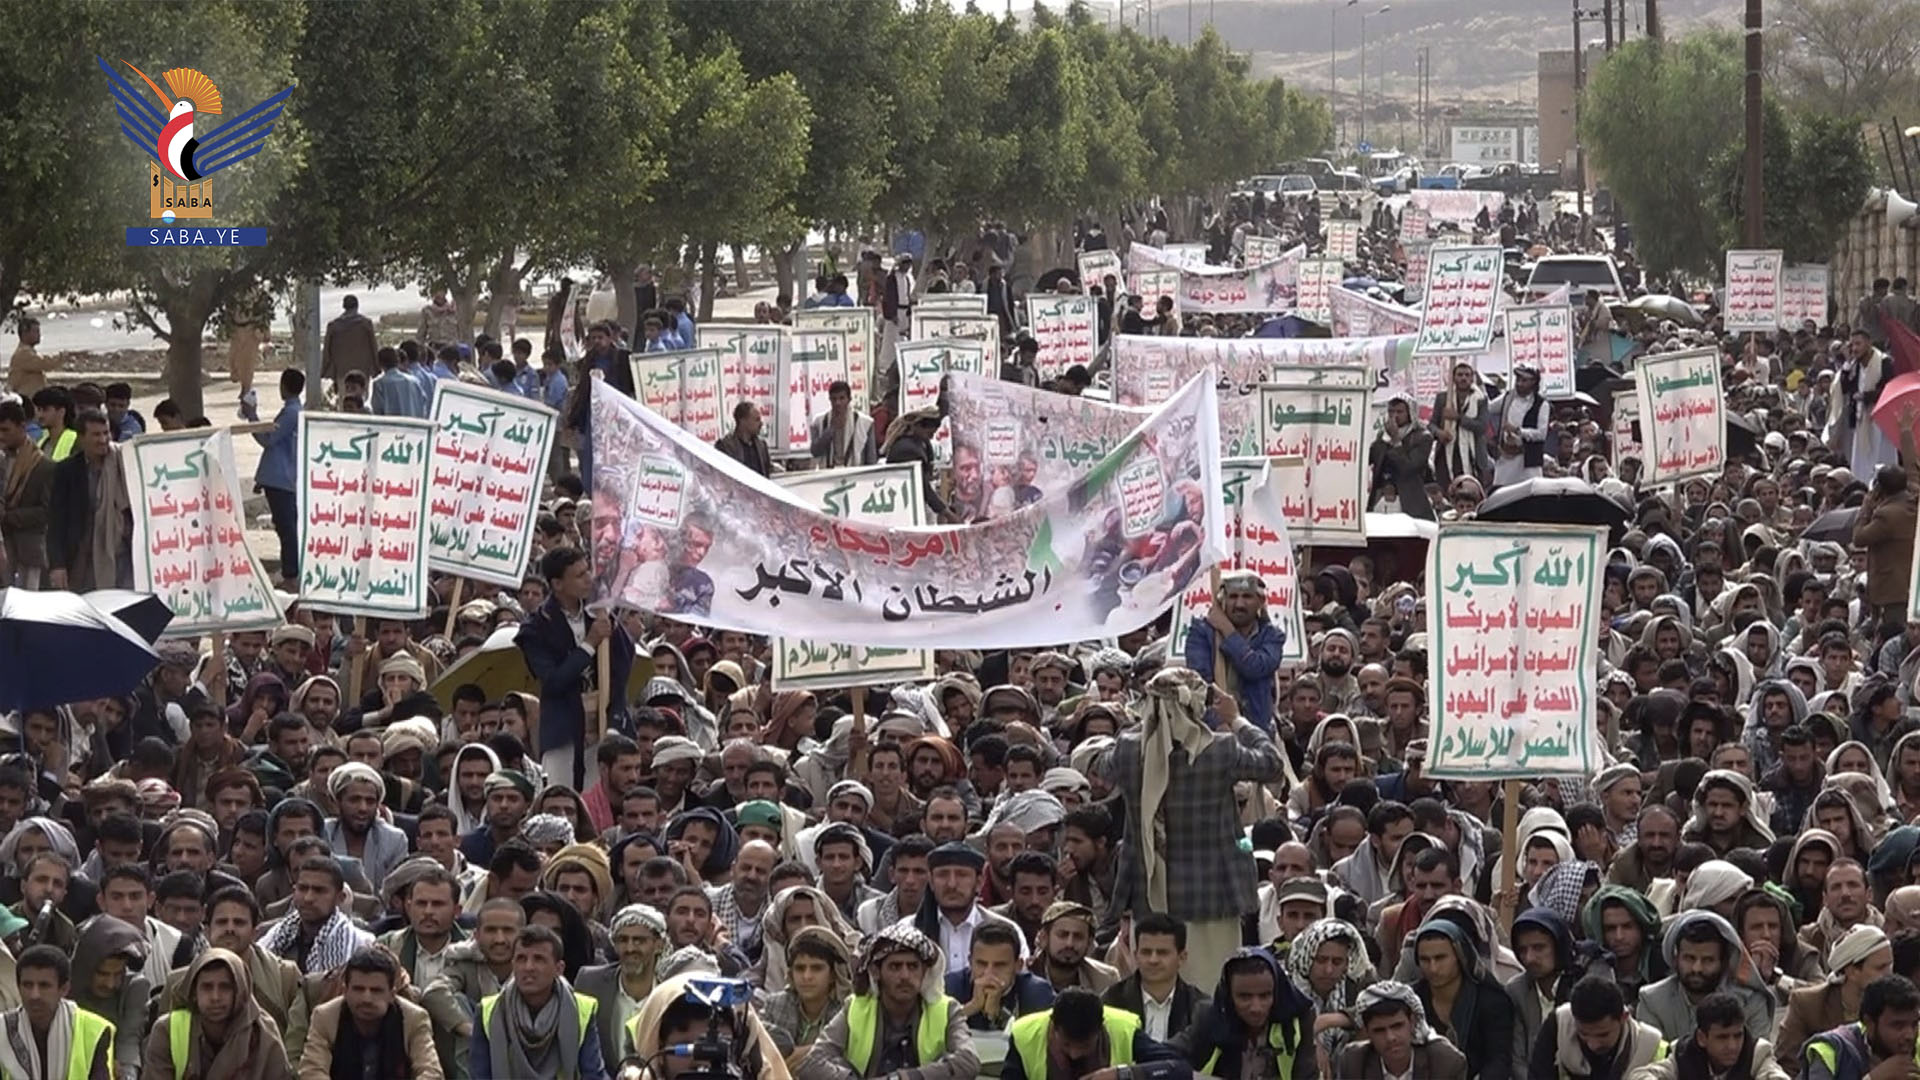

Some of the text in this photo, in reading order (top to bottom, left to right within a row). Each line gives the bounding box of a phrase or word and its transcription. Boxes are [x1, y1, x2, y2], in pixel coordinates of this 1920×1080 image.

[1650, 364, 1714, 398] قاطعوا
[443, 406, 544, 445] الله أكبر
[1269, 397, 1353, 432] قاطعوا
[311, 426, 424, 468] الله أكبر
[492, 453, 536, 475] الموت
[310, 468, 420, 500] الموت لأمريكا
[486, 482, 530, 503] الموت
[821, 478, 909, 519] الله أك
[309, 502, 418, 532] الموت لإسرائيل
[431, 499, 525, 531] اللعنة على اليهو
[307, 535, 415, 563] اللعنة على اليهود
[430, 521, 520, 561] النصر للإسلا
[153, 559, 198, 589] اليهود
[202, 558, 225, 584] على
[302, 563, 414, 600] النصر للإسلام
[1445, 540, 1585, 599] الله أكبر
[167, 589, 212, 618] للإسلا
[881, 563, 1052, 622] الشيطان
[1446, 595, 1582, 634] الموت لأمريكا
[1446, 641, 1578, 678] الموت لإسرائيل
[1446, 685, 1579, 720] اللعنة على اليهود
[1440, 720, 1579, 770] النصر للإسلام
